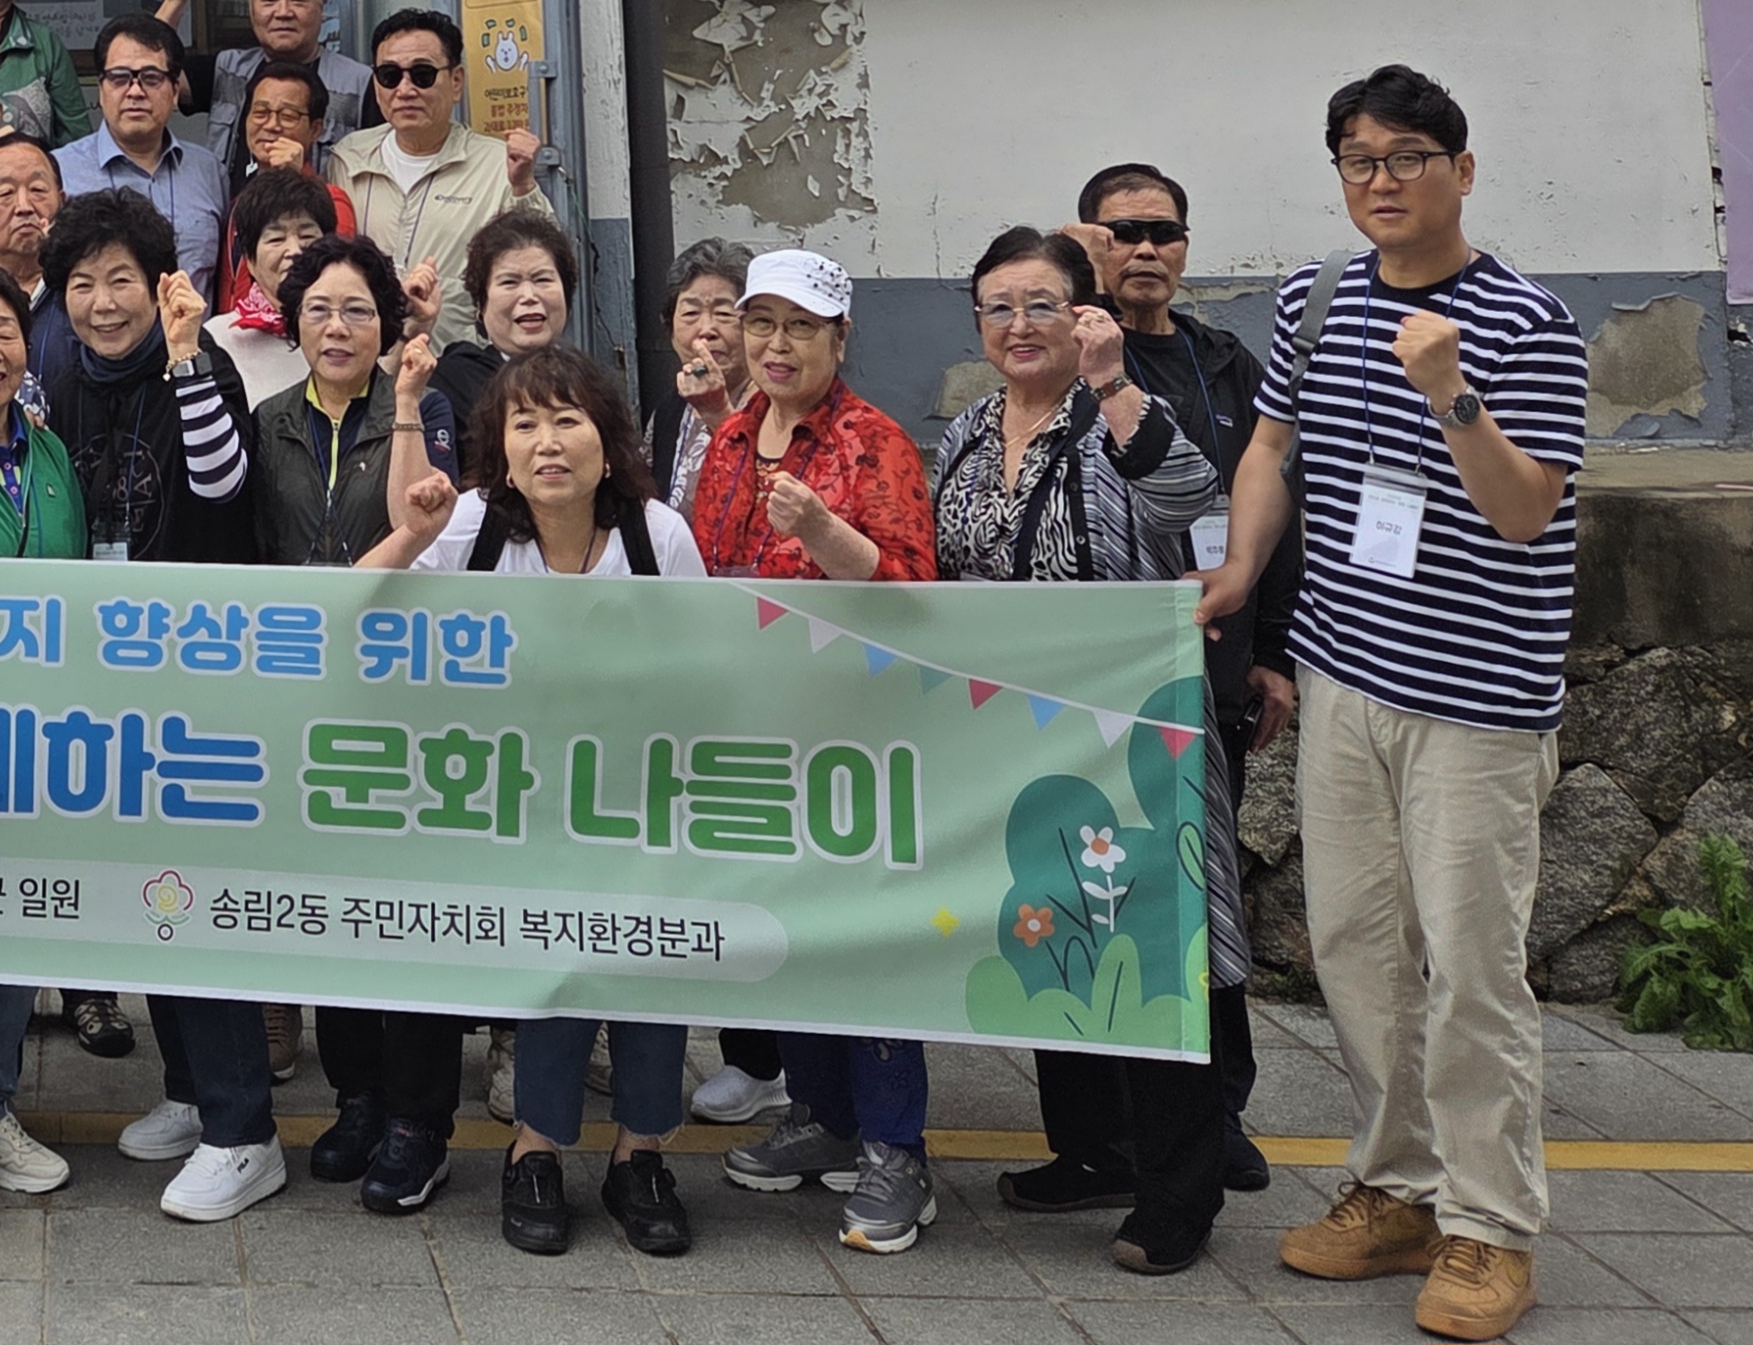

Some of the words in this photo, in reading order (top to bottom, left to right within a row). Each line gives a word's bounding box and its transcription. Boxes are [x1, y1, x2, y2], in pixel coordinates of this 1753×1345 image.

[484, 85, 528, 102] 어린이보호구
[98, 599, 328, 680] 향상을
[356, 605, 517, 688] 위한
[298, 719, 539, 844] 문화
[566, 732, 923, 870] 나들이
[19, 877, 81, 920] 일원
[210, 888, 329, 937] 송림2동
[340, 897, 506, 949] 주민자치회
[519, 908, 726, 963] 복지환경분과
